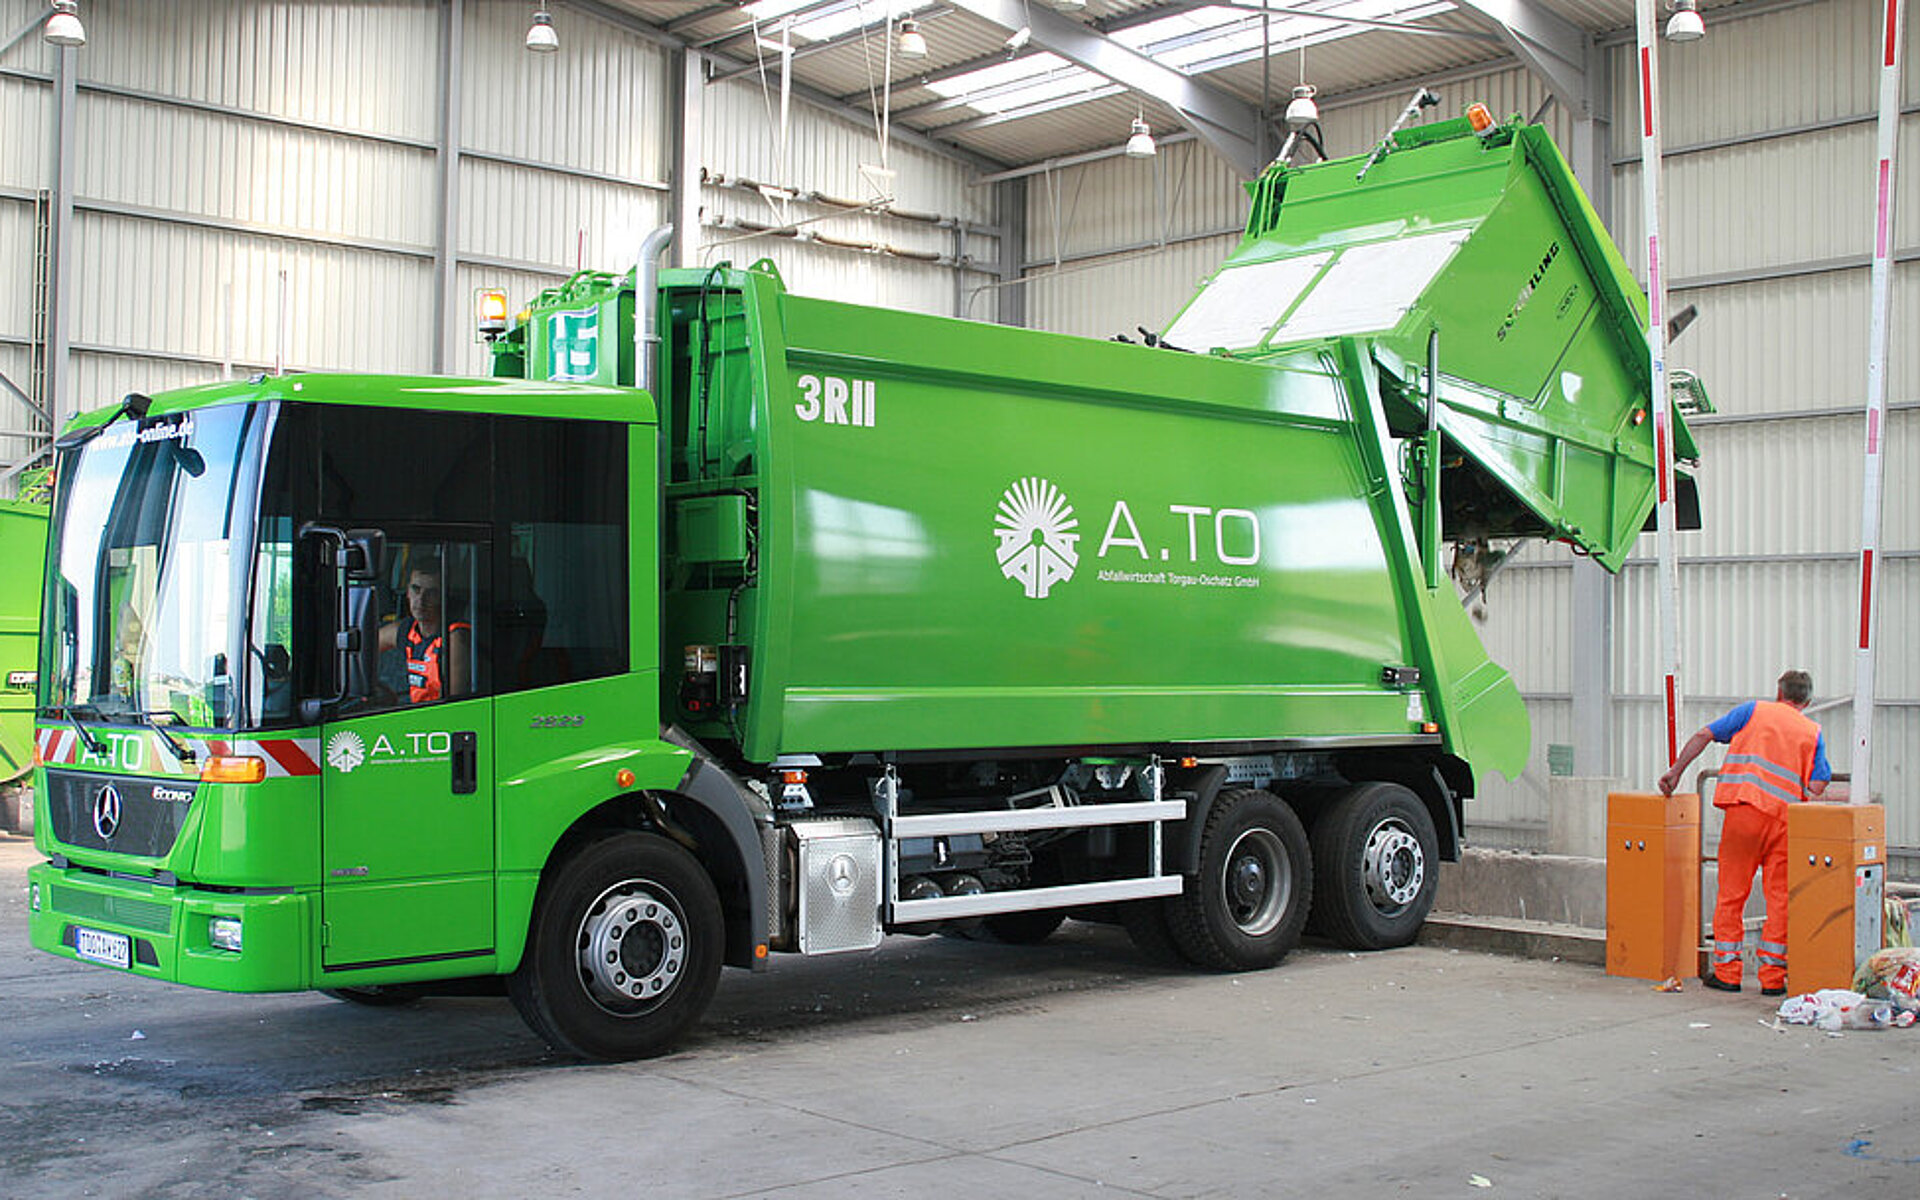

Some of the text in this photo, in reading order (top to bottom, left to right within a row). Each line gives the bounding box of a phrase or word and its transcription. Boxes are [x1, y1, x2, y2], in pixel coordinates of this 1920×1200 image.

[1097, 500, 1260, 565] A.TO
[1097, 569, 1260, 588] Abfallwirtschaft Torgau-Oschatz GmbH
[80, 732, 144, 771] A.TO
[370, 731, 451, 757] A.TO
